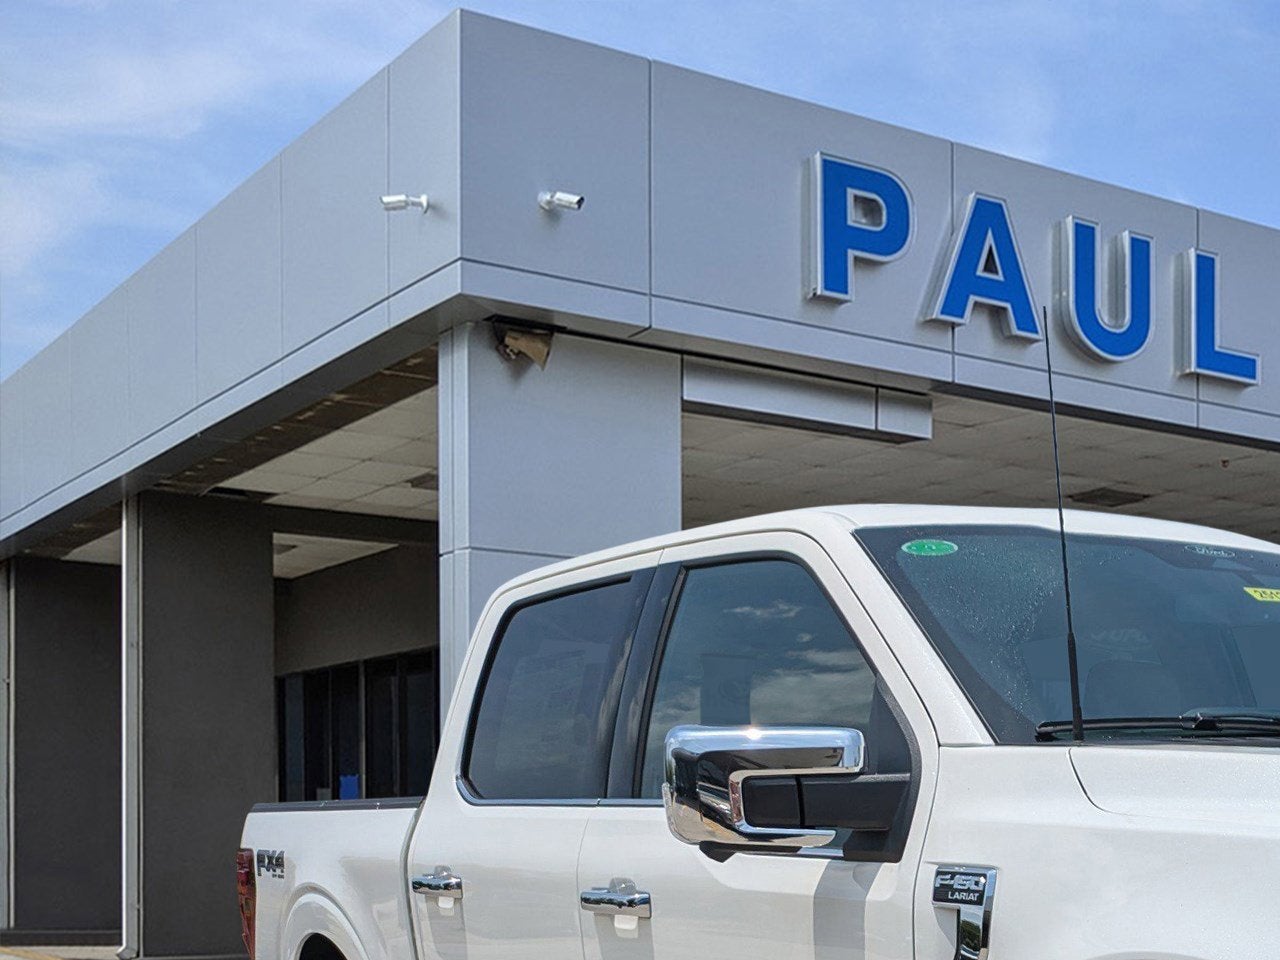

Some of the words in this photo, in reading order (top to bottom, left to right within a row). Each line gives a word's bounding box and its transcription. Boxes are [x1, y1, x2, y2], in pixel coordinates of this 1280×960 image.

[809, 151, 1261, 386] PAUL
[257, 849, 285, 876] FX4
[948, 891, 979, 900] LARIAT
